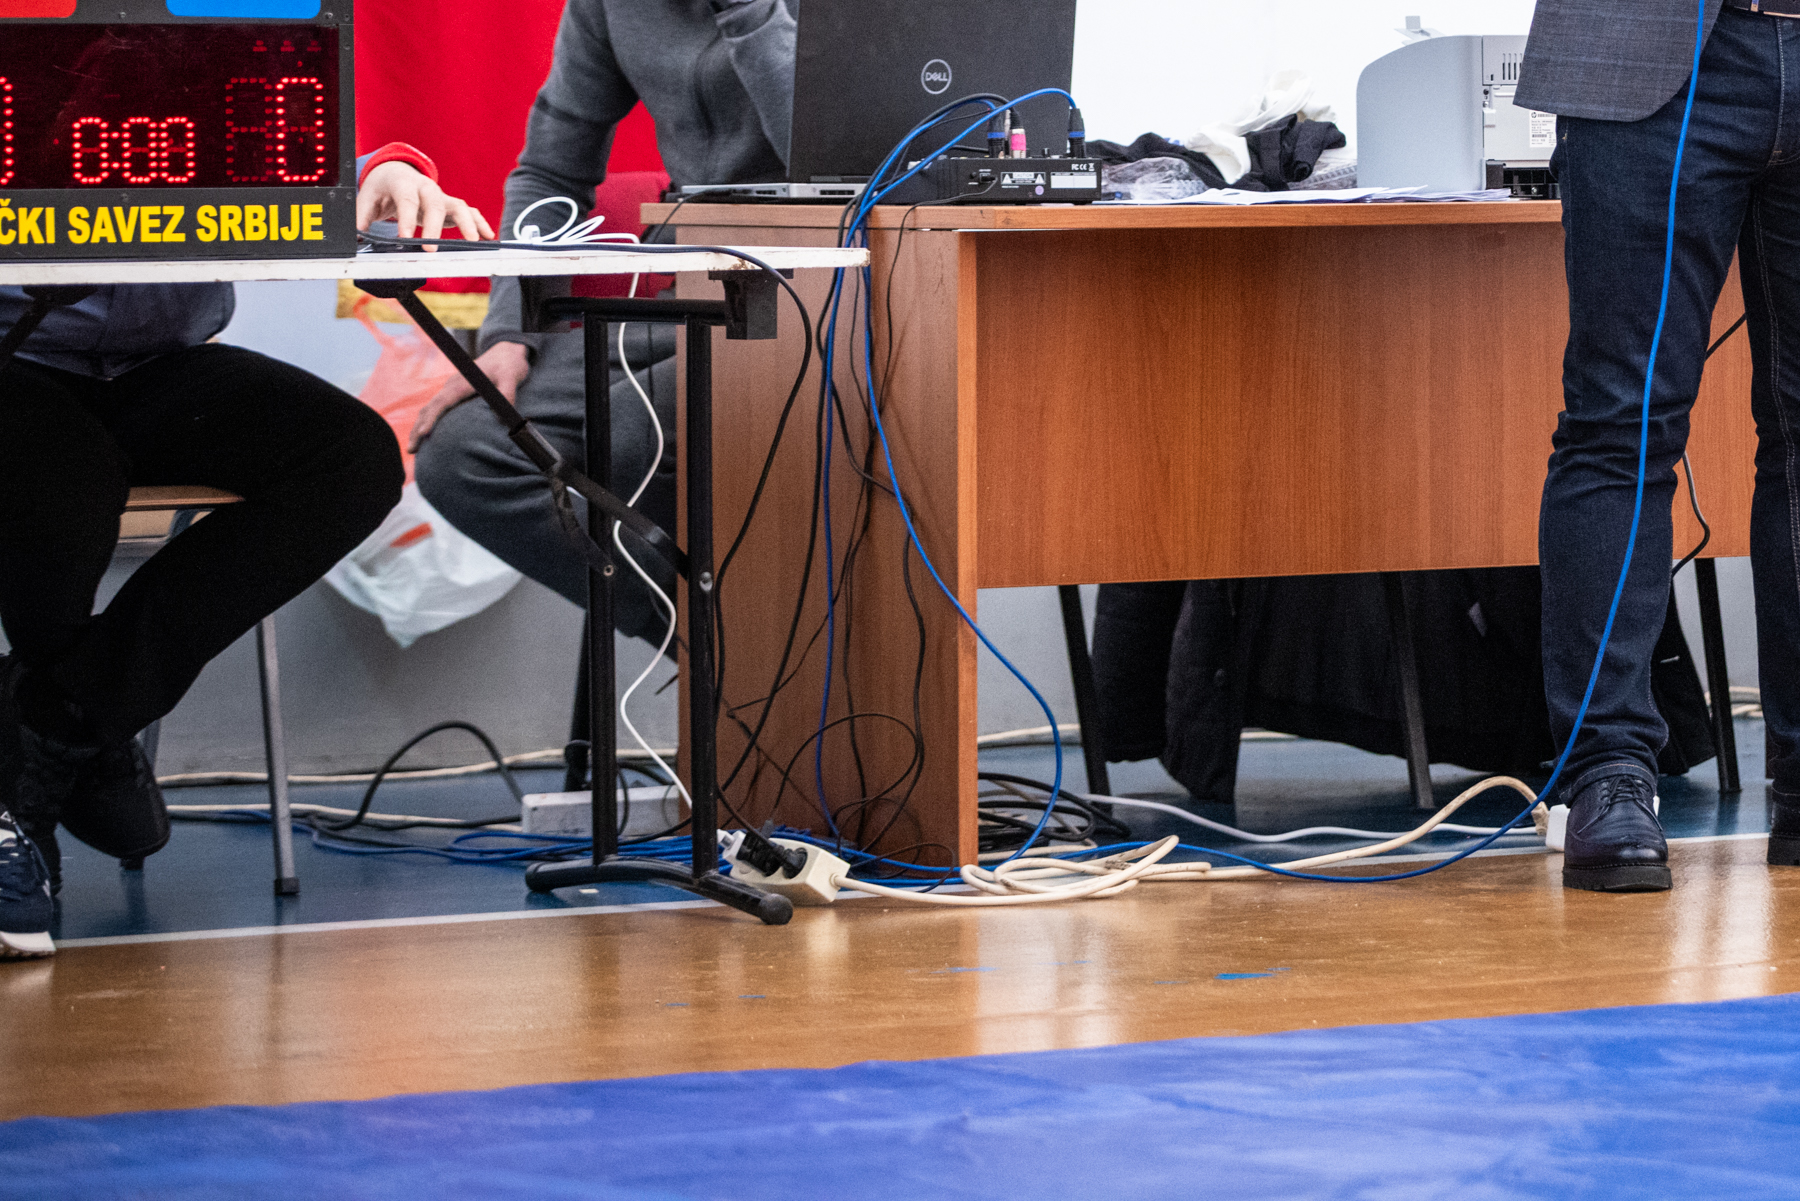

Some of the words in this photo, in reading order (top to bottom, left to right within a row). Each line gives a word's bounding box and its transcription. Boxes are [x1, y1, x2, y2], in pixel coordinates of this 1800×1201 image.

[925, 71, 949, 82] DELL
[73, 116, 196, 184] 0:00
[276, 76, 326, 182] 0
[67, 205, 186, 244] SAVEZ
[196, 203, 324, 242] SRBIJE
